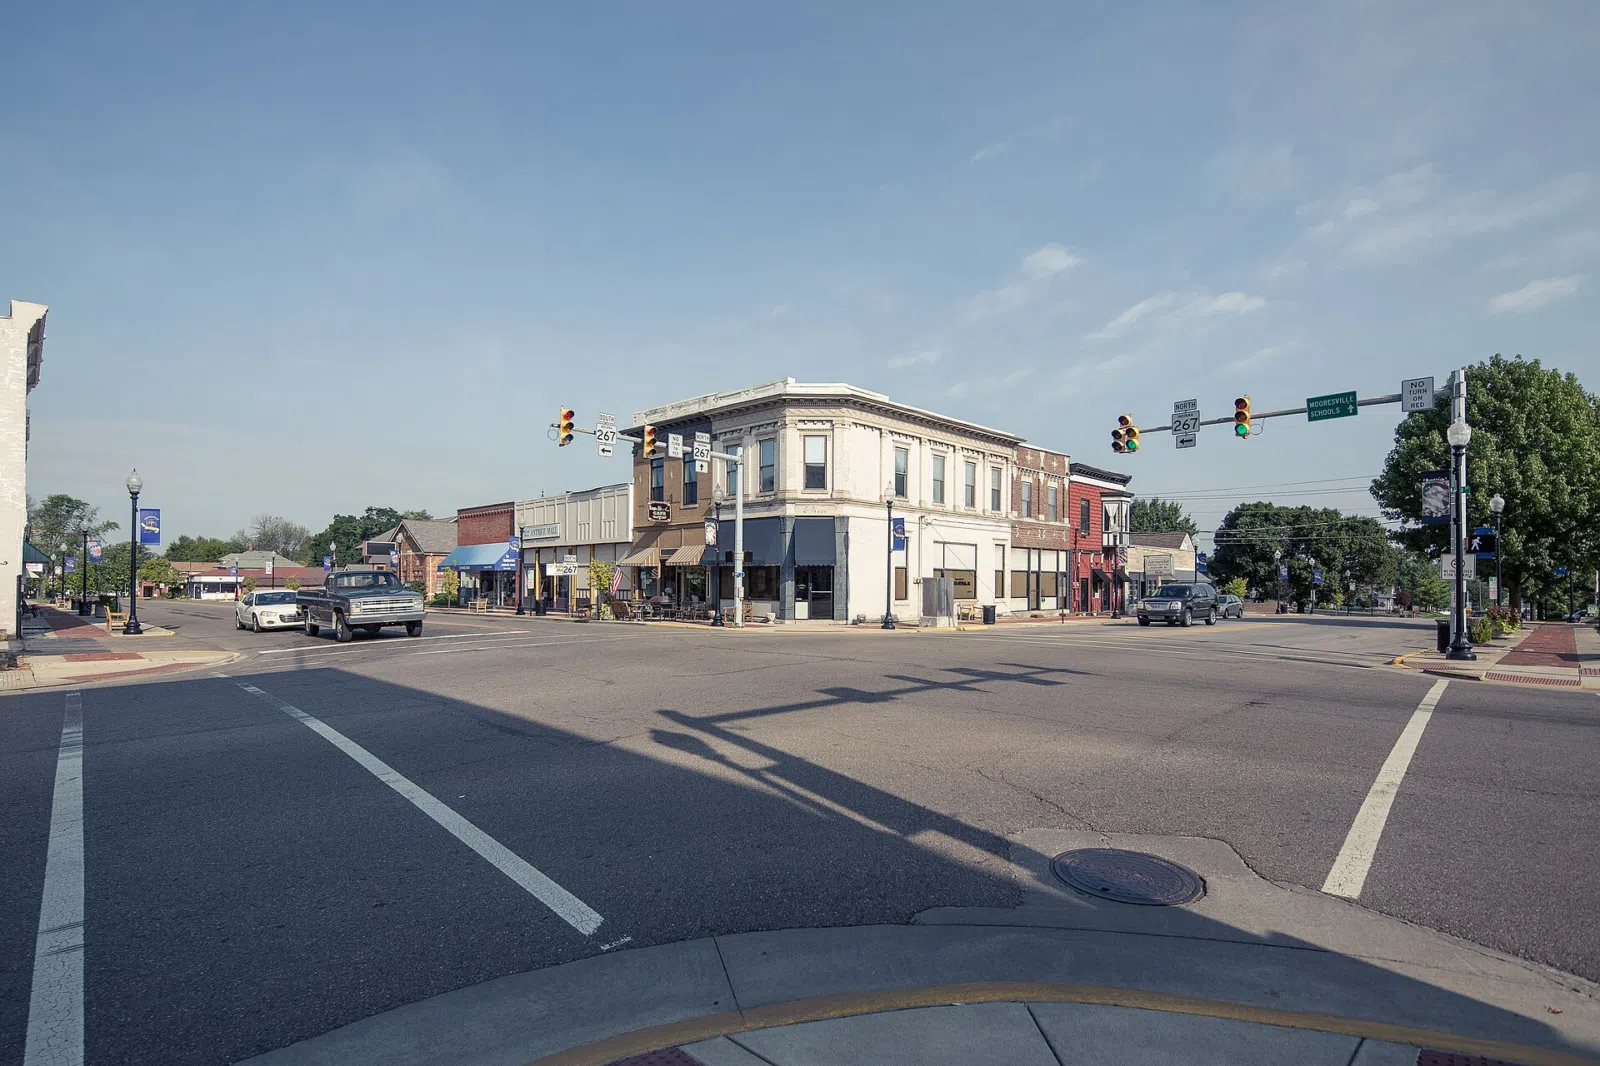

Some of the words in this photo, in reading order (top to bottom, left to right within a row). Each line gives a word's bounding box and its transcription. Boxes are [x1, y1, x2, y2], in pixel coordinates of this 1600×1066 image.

[1410, 380, 1425, 389] NO
[1175, 401, 1196, 410] NORTH
[1309, 395, 1354, 408] MOORESVILLE
[1310, 407, 1340, 418] SCHOOLS
[599, 414, 614, 422] SOUTH
[1173, 418, 1198, 432] 267
[596, 429, 616, 442] 267
[694, 447, 710, 458] 267
[547, 526, 557, 535] MALL
[563, 565, 578, 574] 267
